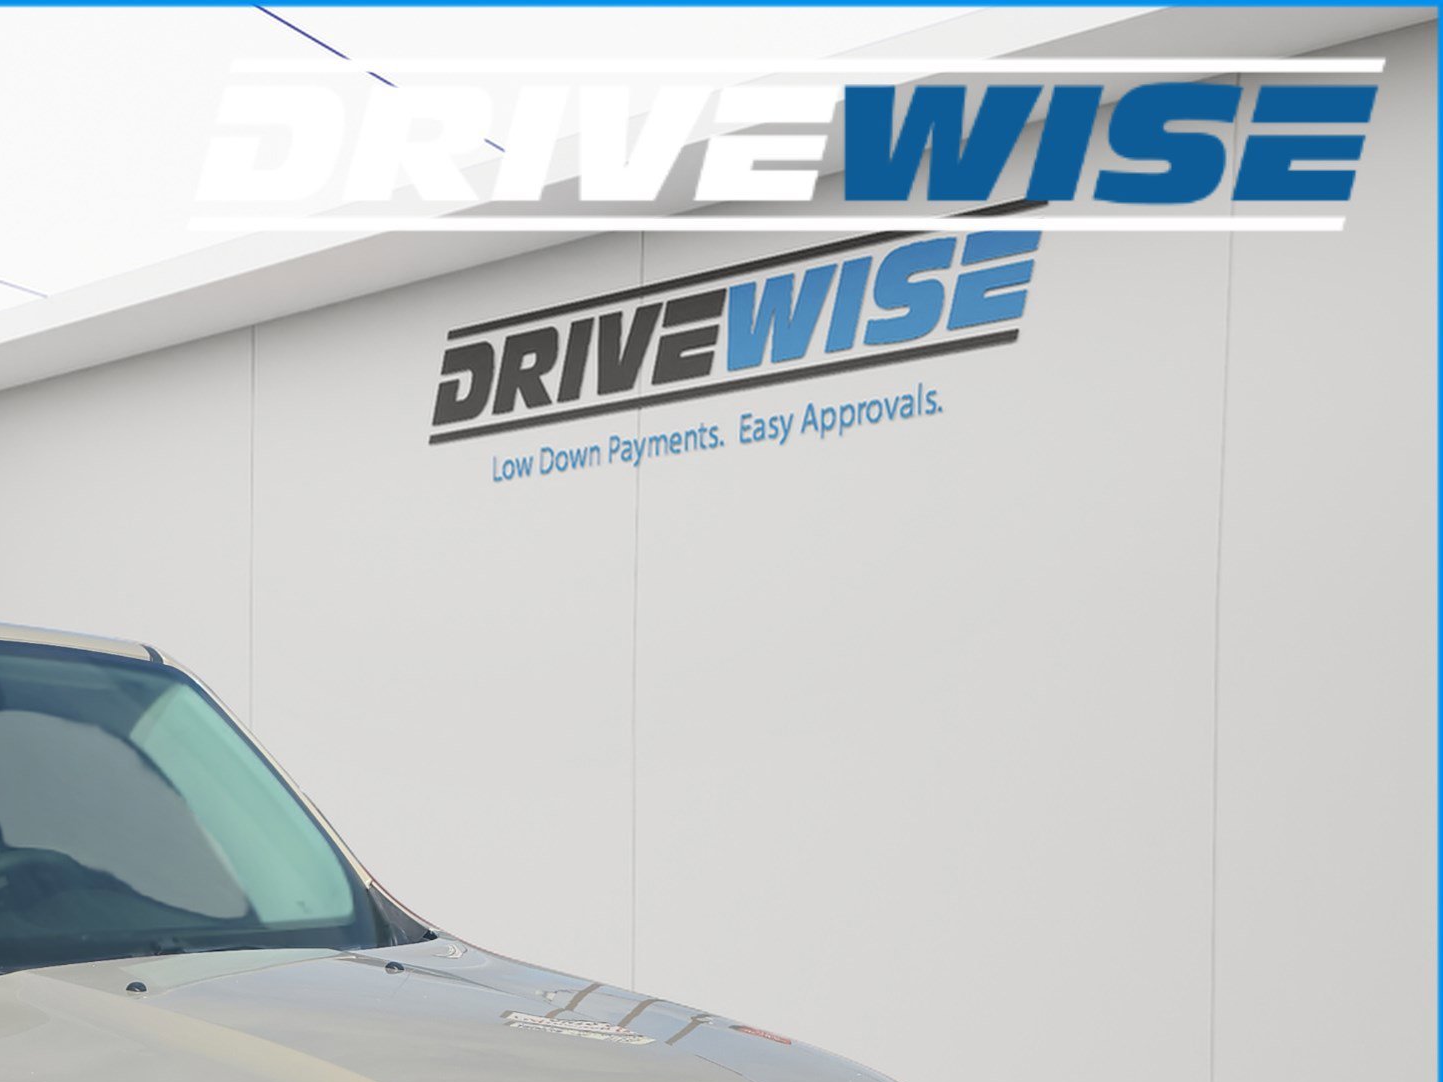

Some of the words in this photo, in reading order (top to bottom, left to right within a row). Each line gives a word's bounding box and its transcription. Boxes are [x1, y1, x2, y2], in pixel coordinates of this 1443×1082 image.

[431, 229, 1043, 428] DRIVEWISE
[492, 454, 534, 483] Low
[539, 441, 601, 476] Down
[608, 421, 725, 467] Payments.
[738, 409, 794, 446] Easy
[800, 382, 944, 440] Approvals.
